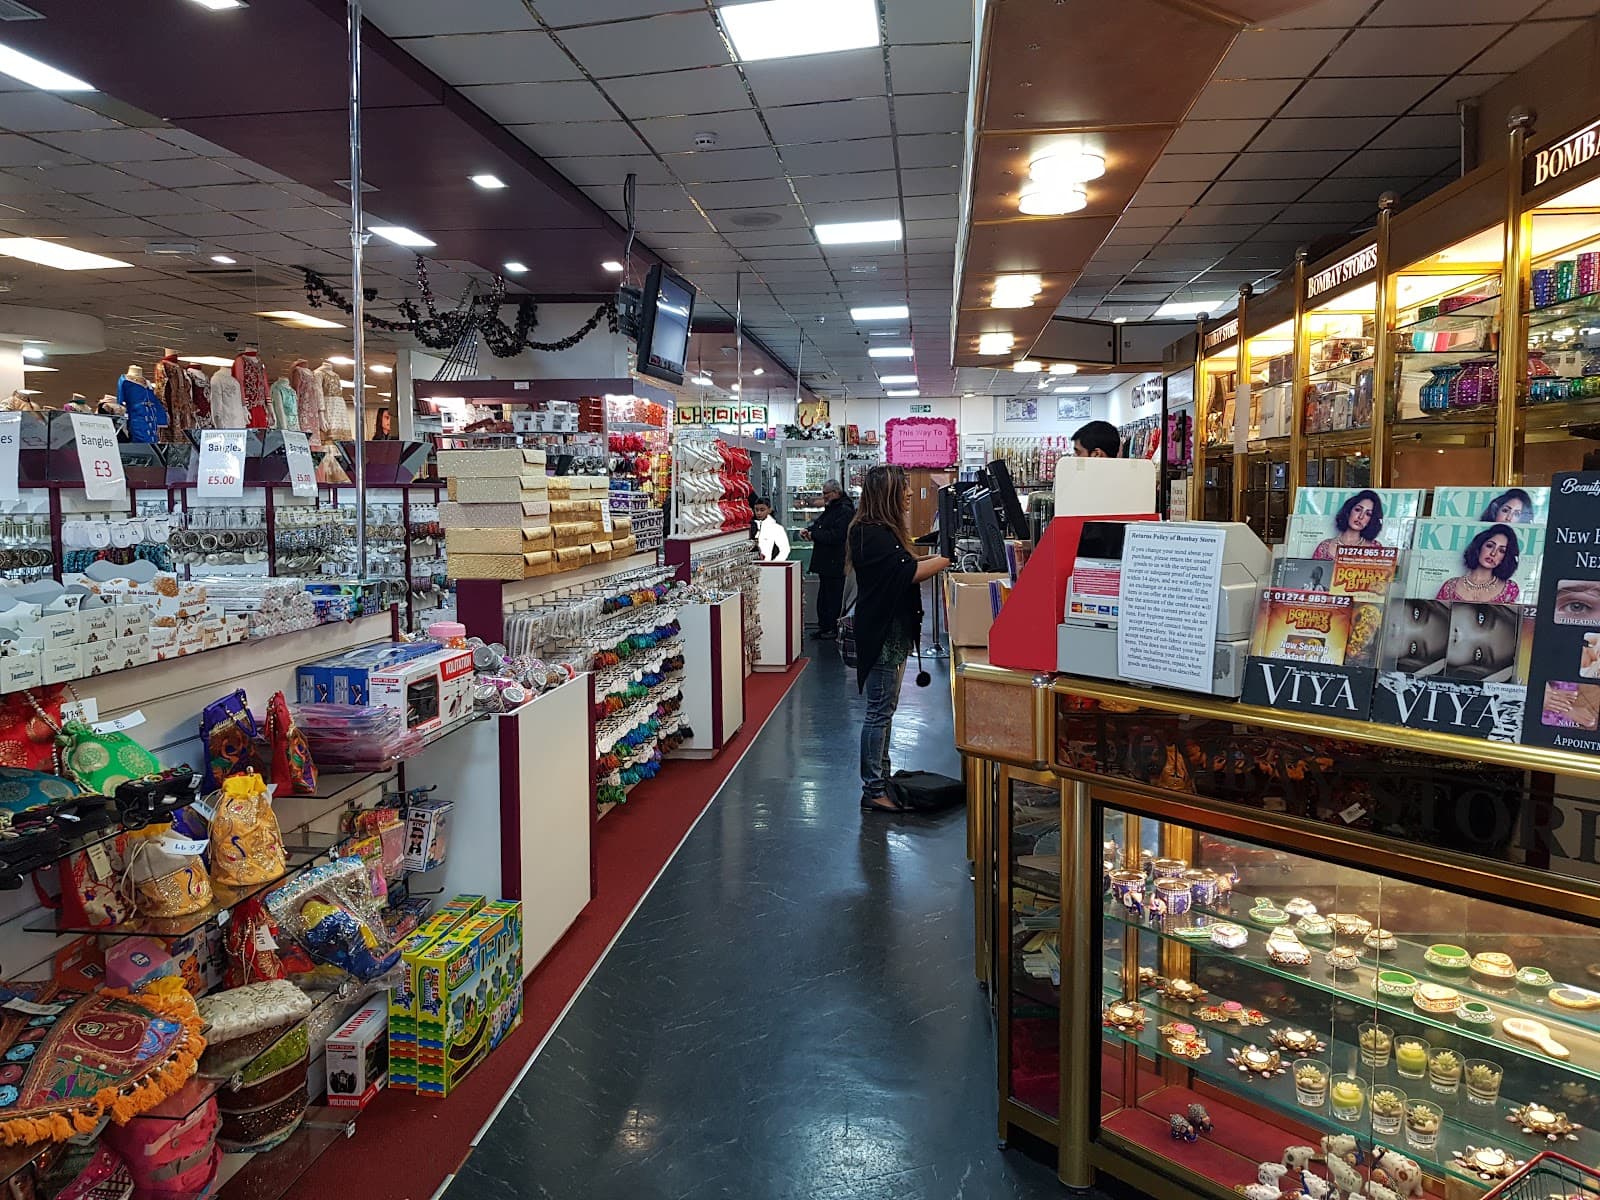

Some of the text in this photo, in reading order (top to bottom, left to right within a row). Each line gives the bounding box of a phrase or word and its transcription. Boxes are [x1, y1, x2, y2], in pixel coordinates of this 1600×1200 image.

[1534, 125, 1600, 187] BOMB
[1307, 246, 1377, 299] BOMBAY STORES
[81, 434, 114, 448] Bangles
[208, 443, 241, 453] Bangles
[94, 460, 112, 477] £3
[208, 475, 235, 485] £5.00
[1560, 477, 1600, 496] Beauty
[1299, 490, 1413, 518] KHSH
[1152, 533, 1168, 541] Policy
[1175, 535, 1198, 543] Bombay
[1419, 523, 1545, 555] KHSH
[1339, 547, 1396, 558] 01274 965 122
[1575, 551, 1600, 568] NE
[1179, 563, 1198, 571] original
[1171, 570, 1185, 578] proof
[1336, 567, 1390, 583] BOMBAY
[1135, 581, 1156, 590] exchange
[1348, 579, 1385, 592] BITES
[1274, 591, 1305, 602] 01274
[1308, 594, 1328, 603] 965
[1331, 596, 1350, 605] 122
[1134, 603, 1146, 611] equal
[1523, 607, 1538, 617] 22
[1288, 608, 1332, 621] BOMBAY
[1560, 617, 1600, 625] THREADIN
[1297, 619, 1330, 631] BITES
[1280, 641, 1329, 653] Now Serving
[446, 655, 472, 675] VOLITATION
